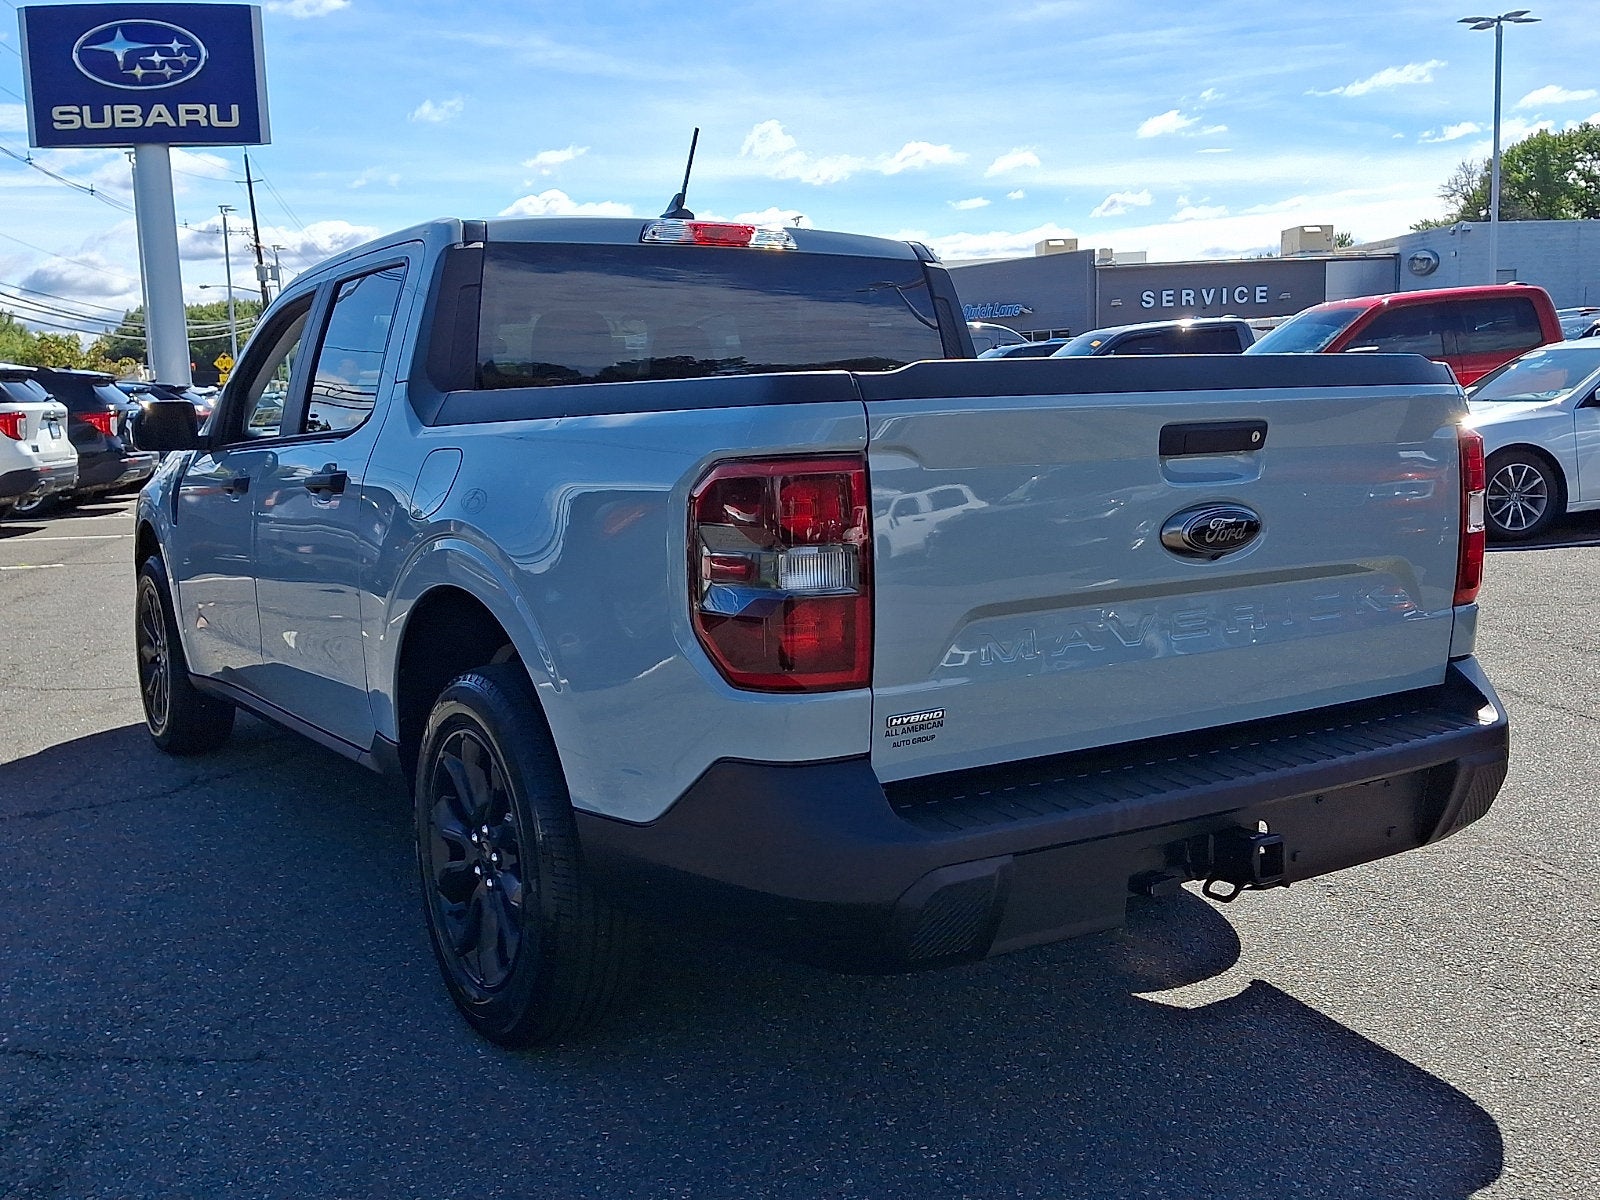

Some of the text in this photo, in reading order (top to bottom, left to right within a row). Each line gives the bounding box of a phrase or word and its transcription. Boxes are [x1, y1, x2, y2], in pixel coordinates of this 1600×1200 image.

[51, 104, 240, 130] SUBARU
[1141, 286, 1268, 309] SERVICE
[963, 302, 1021, 321] Quick Lane
[1205, 517, 1248, 543] Ford
[978, 585, 1395, 667] MAVERICK
[884, 719, 944, 738] ALL AMERICAN
[891, 710, 943, 726] HYBRID
[892, 734, 936, 748] AUTO GROUP
